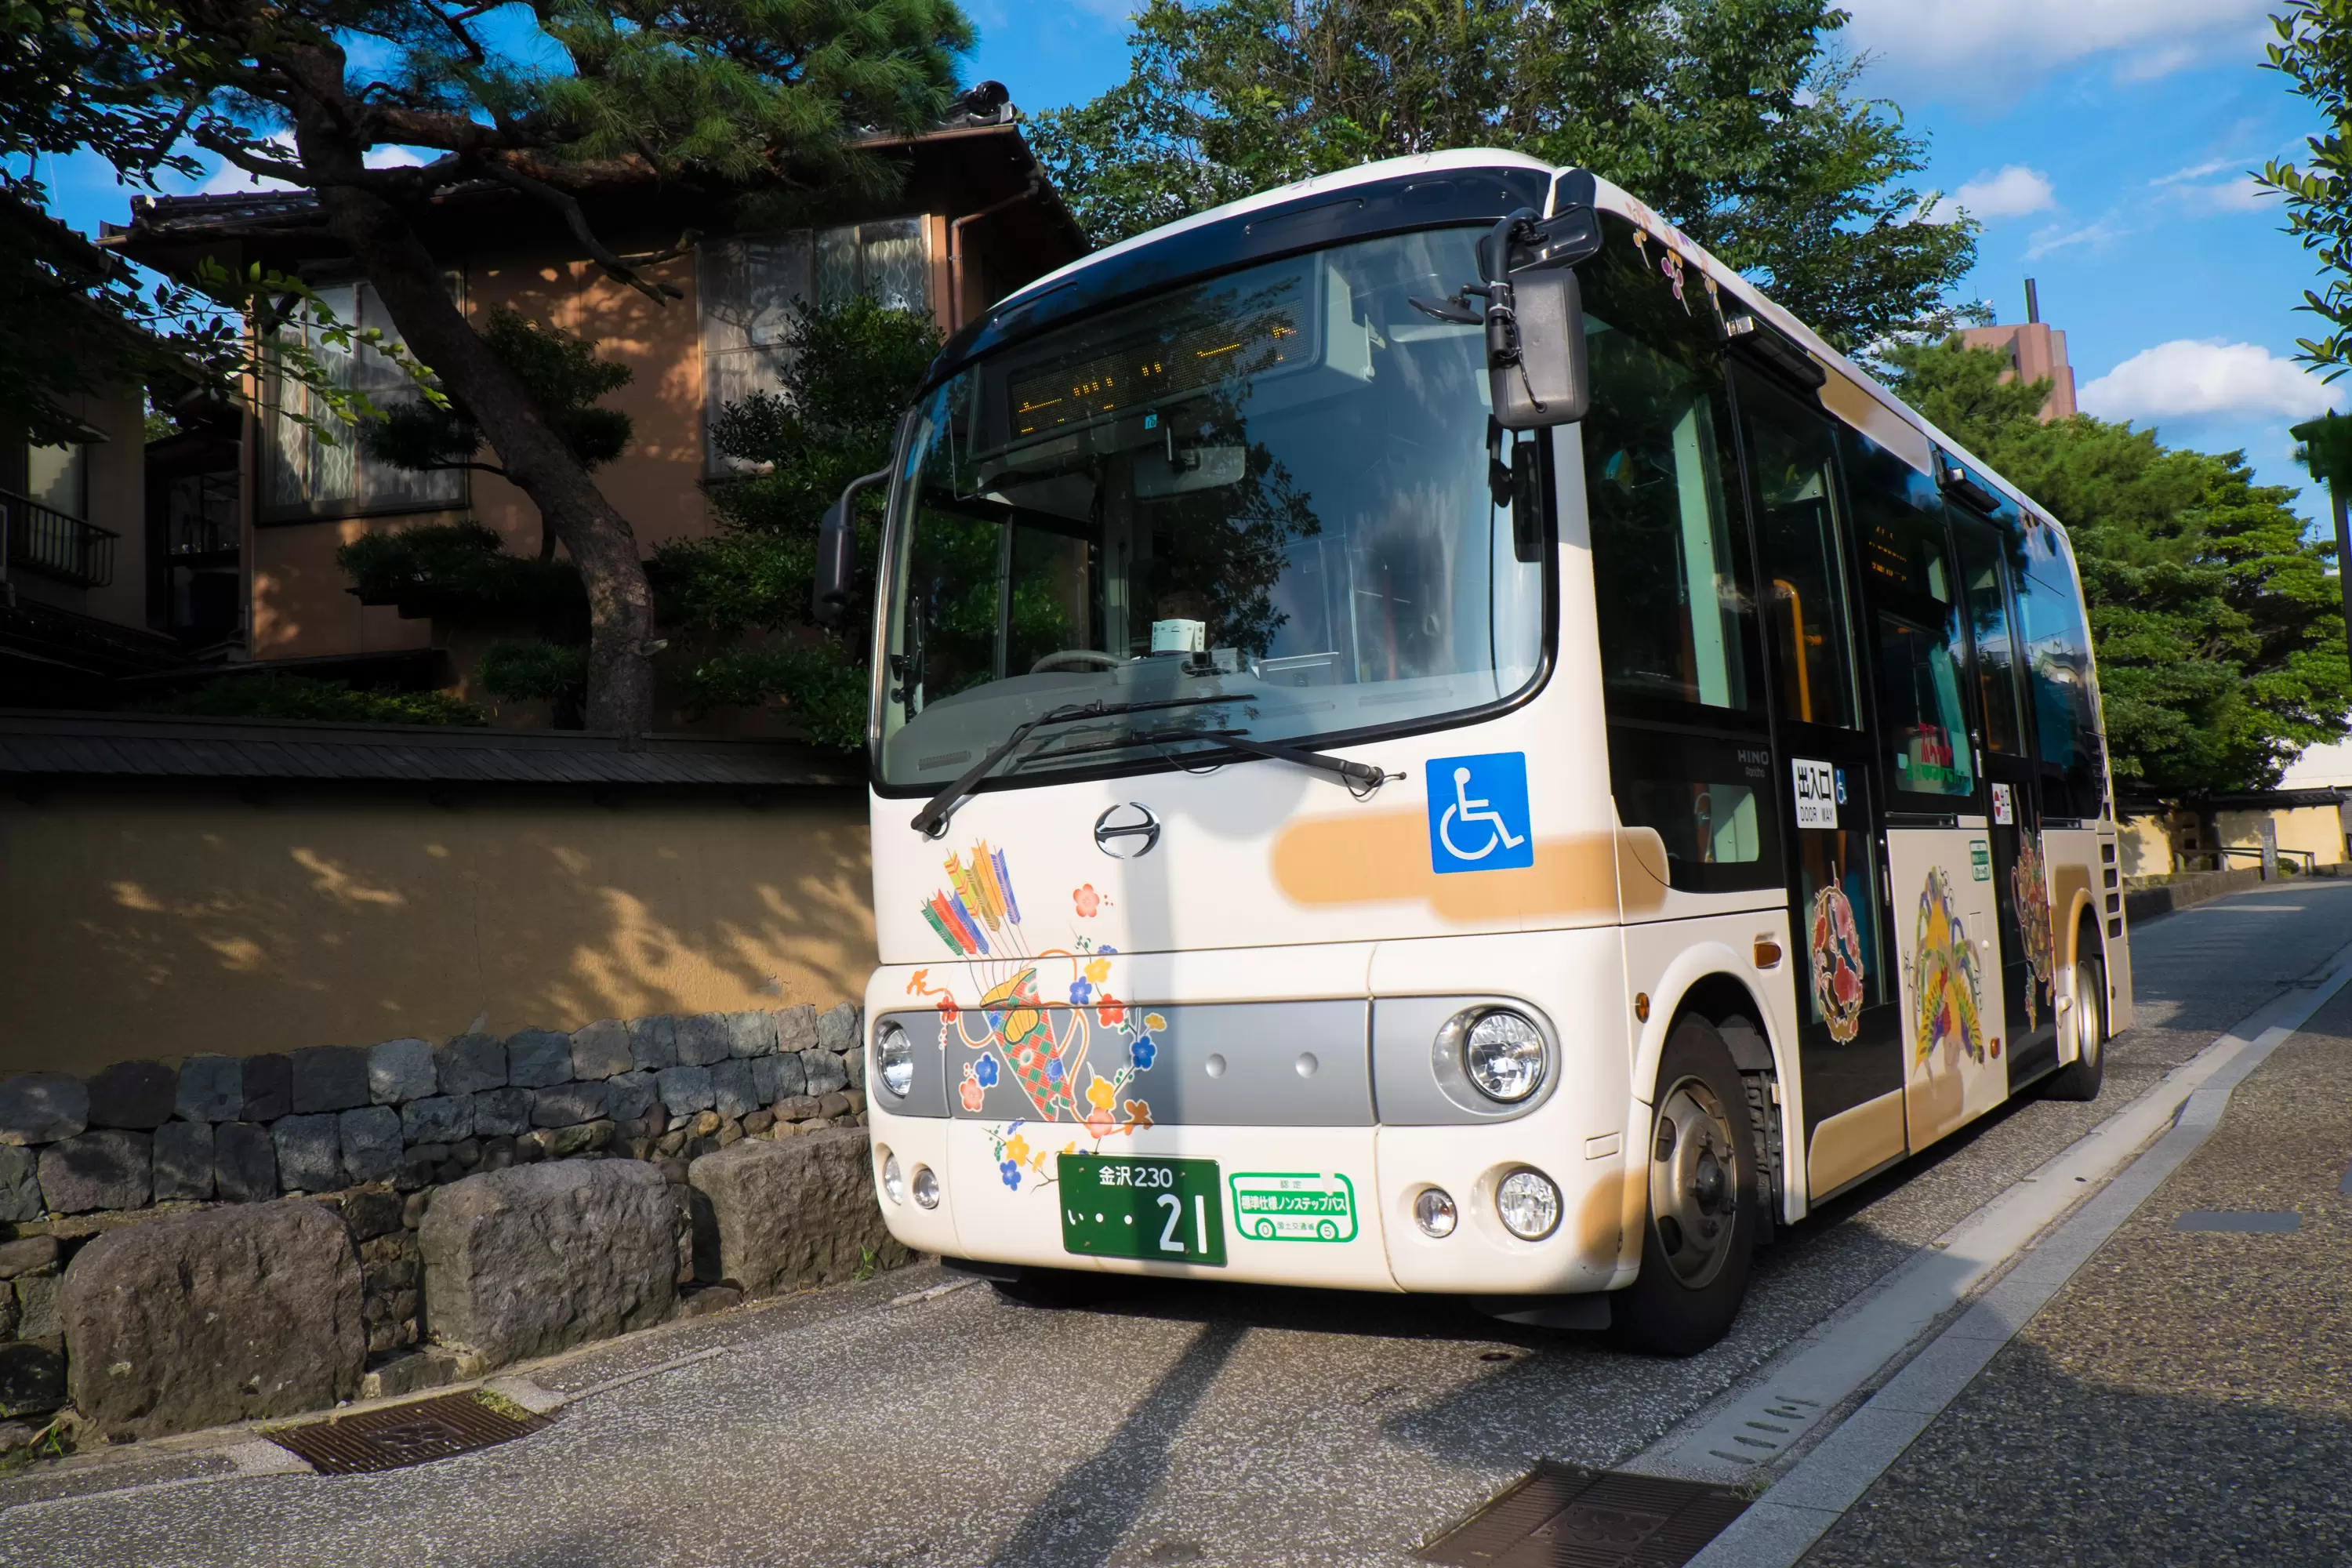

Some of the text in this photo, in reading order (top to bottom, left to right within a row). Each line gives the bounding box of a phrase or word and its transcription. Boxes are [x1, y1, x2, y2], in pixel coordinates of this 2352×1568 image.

[1737, 750, 1769, 765] HINO
[1797, 766, 1831, 800] 出入口
[1800, 806, 1833, 822] DOOR WAY
[1241, 1195, 1346, 1211] 標準仕様ノンステップバス
[1324, 1226, 1332, 1236] 5
